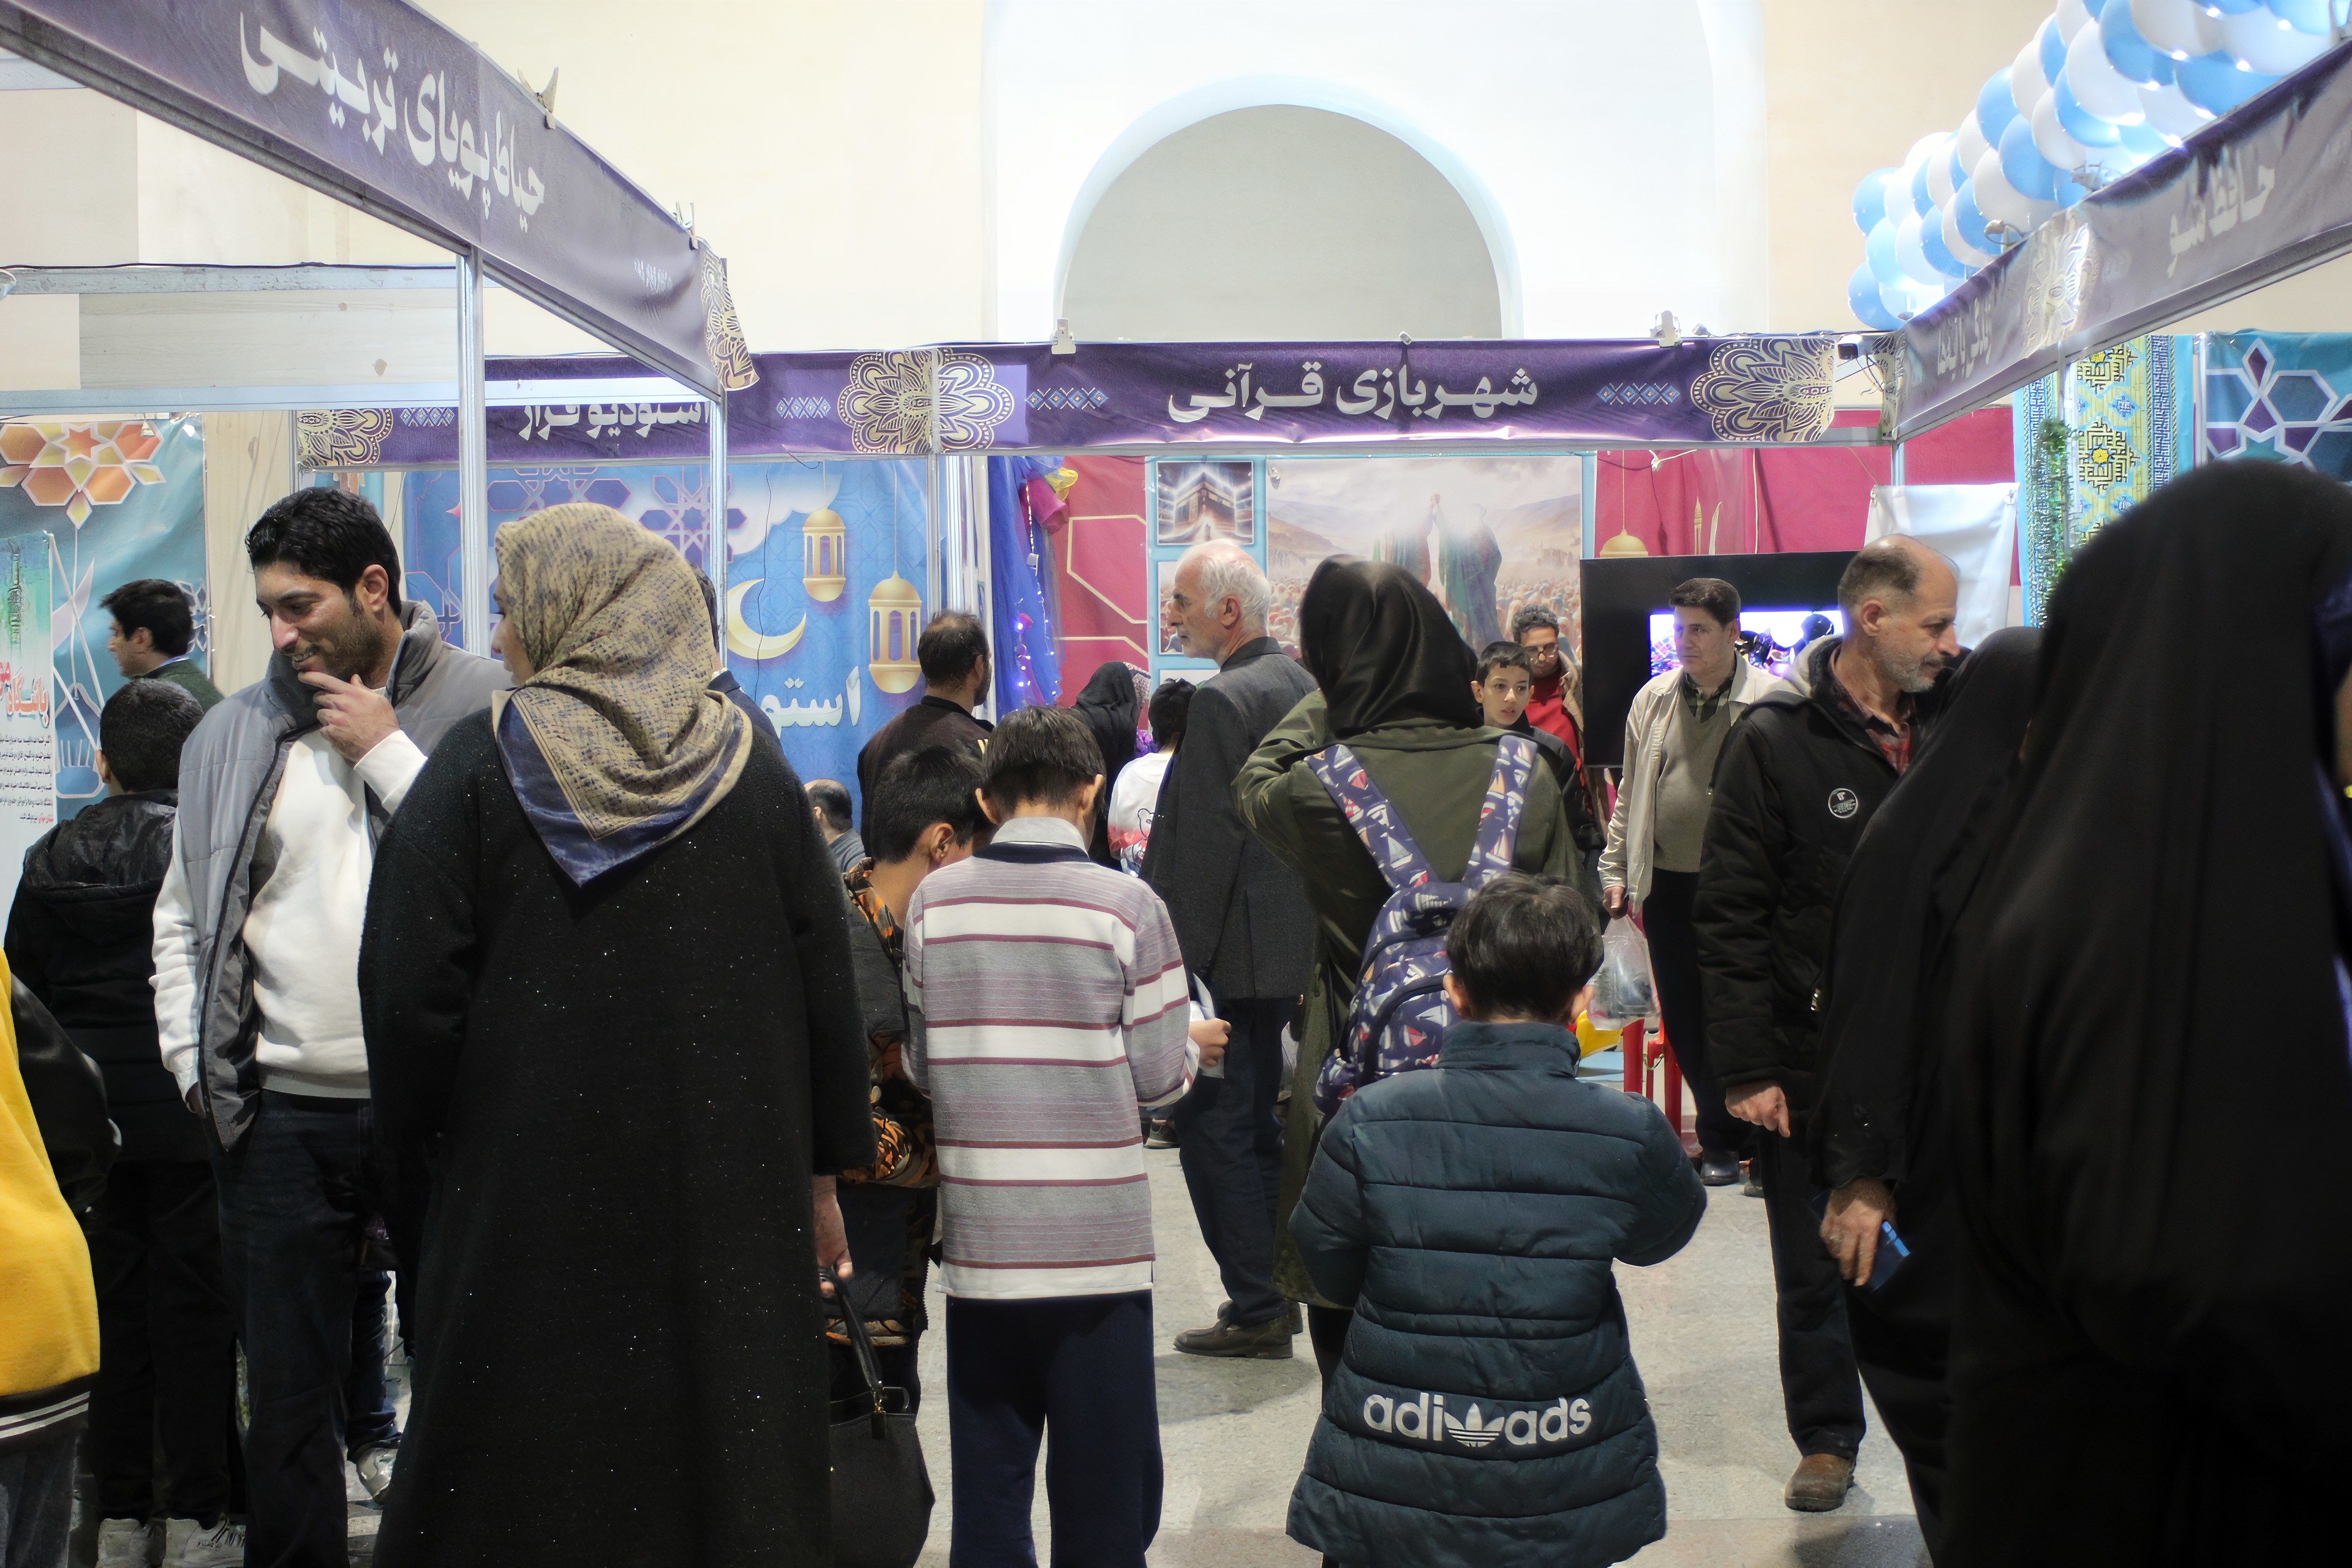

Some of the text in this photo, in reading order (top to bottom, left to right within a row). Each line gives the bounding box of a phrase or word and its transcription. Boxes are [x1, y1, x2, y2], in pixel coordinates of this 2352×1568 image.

[239, 11, 545, 233] حیاط پویای تربیتی
[1167, 361, 1324, 423] قرآنی
